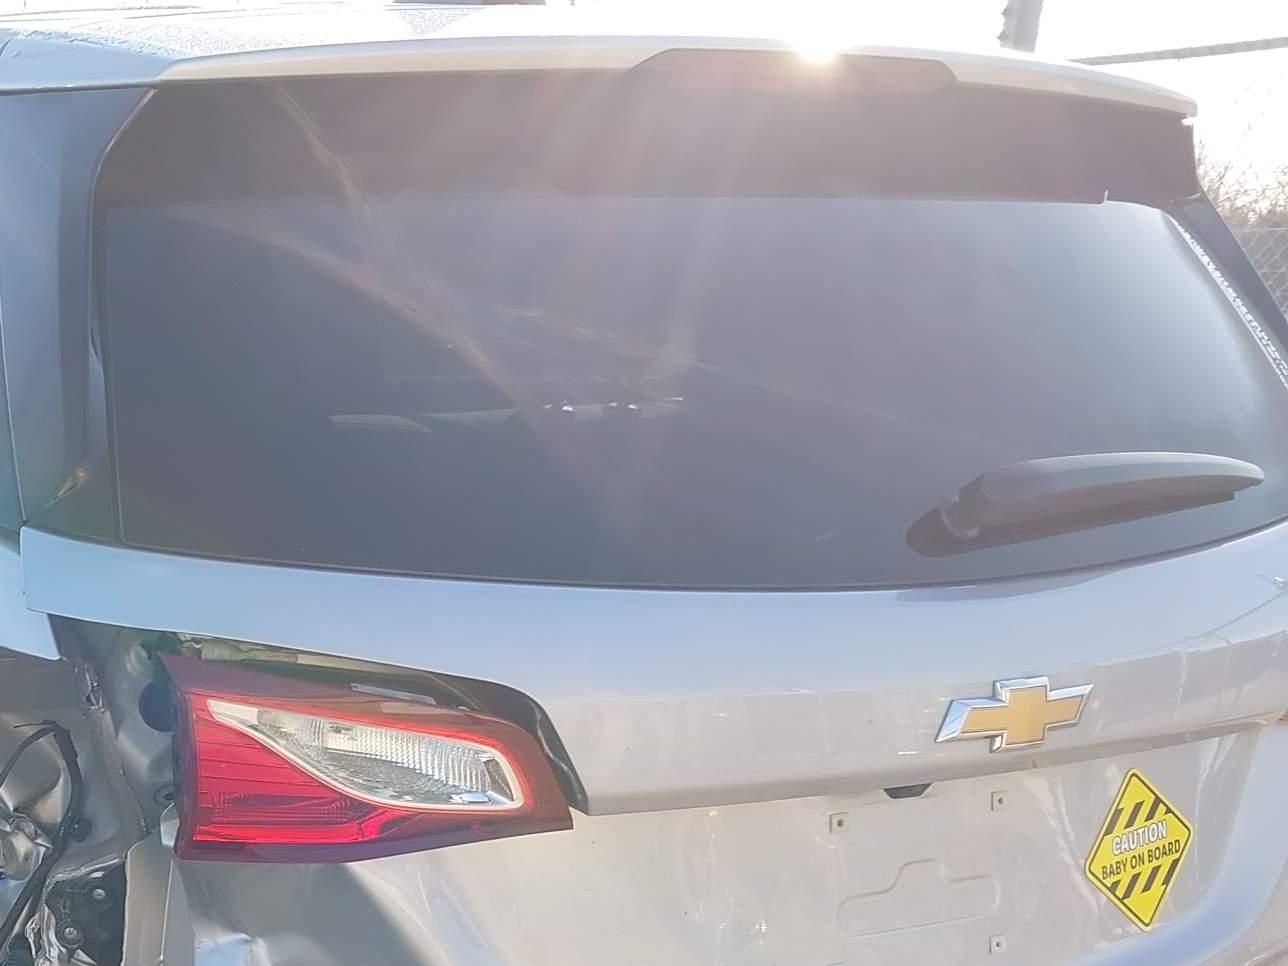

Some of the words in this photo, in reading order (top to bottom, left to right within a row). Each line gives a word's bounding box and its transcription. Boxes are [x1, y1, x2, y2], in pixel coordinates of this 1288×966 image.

[1112, 819, 1167, 856] CAUTION
[1101, 857, 1128, 881] BABY
[1130, 852, 1145, 870] ON
[1147, 839, 1181, 864] BOARD
